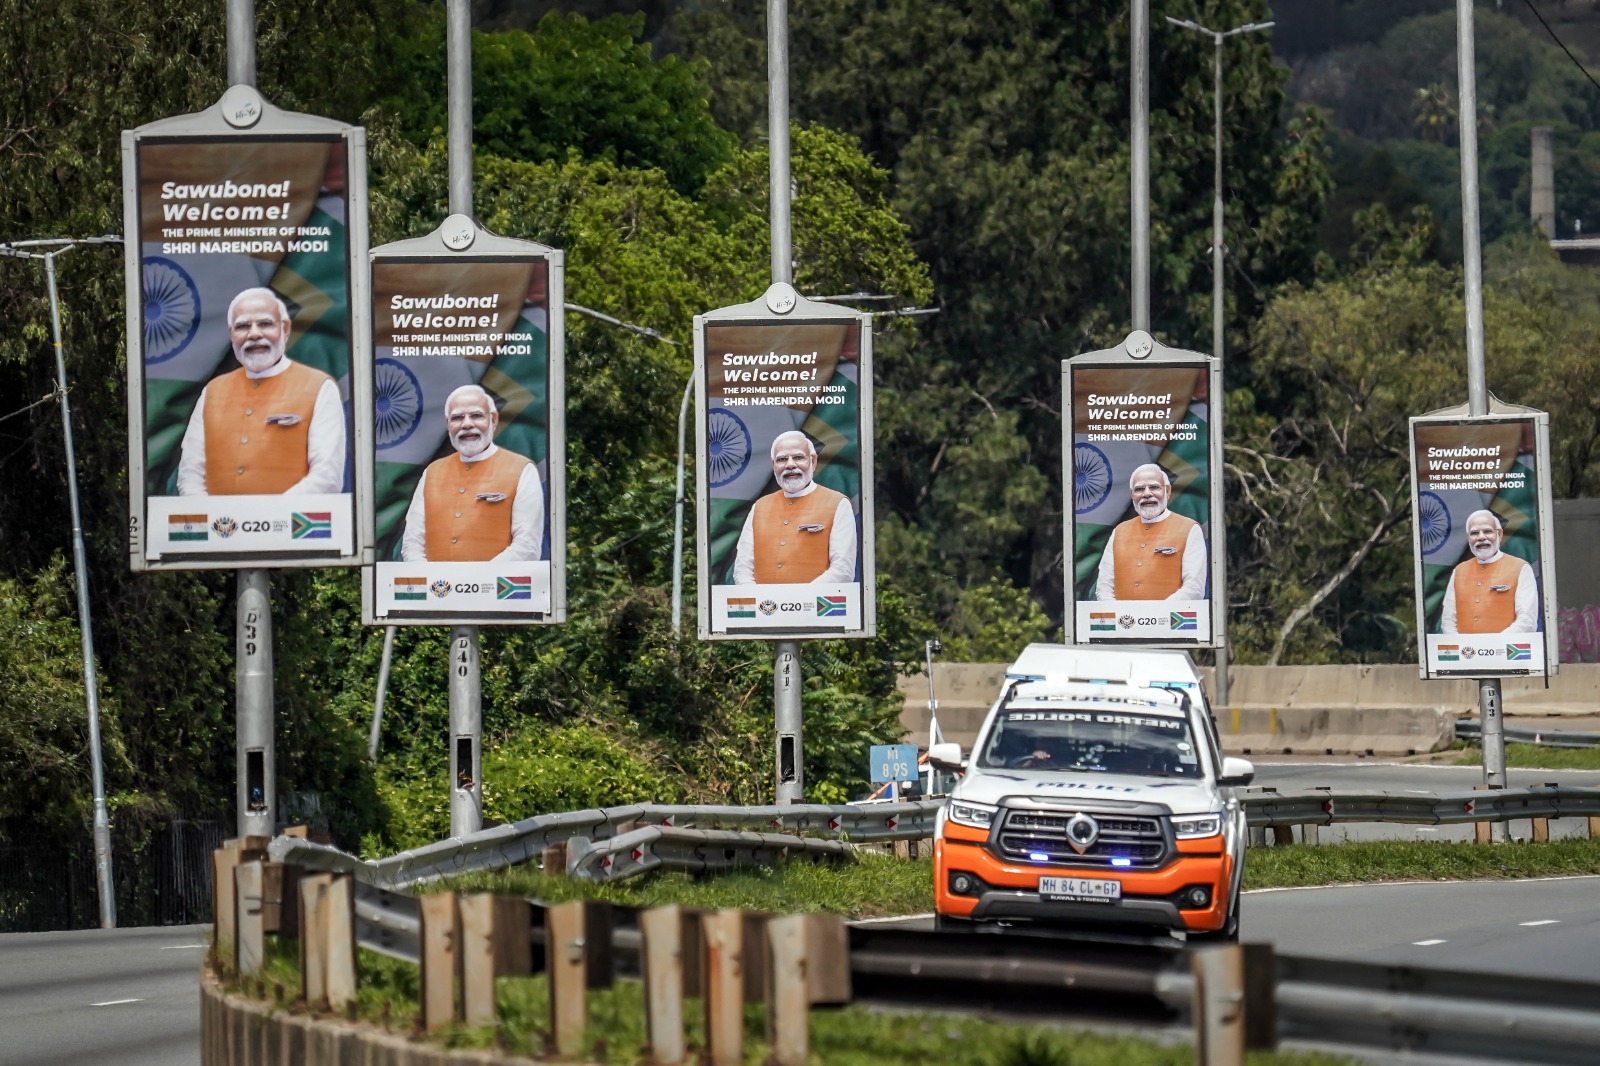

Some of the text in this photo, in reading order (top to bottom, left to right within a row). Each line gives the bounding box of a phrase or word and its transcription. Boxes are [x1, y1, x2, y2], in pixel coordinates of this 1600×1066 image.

[160, 180, 290, 199] Sawubona!
[162, 203, 289, 221] Welcome!
[162, 226, 331, 237] THE PRIME MINISTER OF INDIA
[162, 241, 328, 254] SHRI NARENDRA MODI
[391, 294, 498, 309] Sawubona!
[392, 313, 498, 328] Welcome!
[393, 345, 530, 356] SHRI NARENDRA MODI
[723, 352, 817, 366] Sawubona!
[724, 368, 817, 382] Welcome!
[724, 398, 748, 406] SHRI
[751, 397, 813, 406] NARENDRA
[1087, 394, 1171, 406] Sawubona!
[1088, 408, 1171, 419] Welcome!
[1428, 446, 1500, 457] Sawubona!
[1429, 459, 1500, 470] Welcome!
[242, 521, 270, 532] G20
[455, 584, 479, 593] G20
[781, 603, 801, 611] G20
[1062, 881, 1074, 893] 84
[1080, 882, 1093, 894] CL
[1104, 883, 1117, 895] GP
